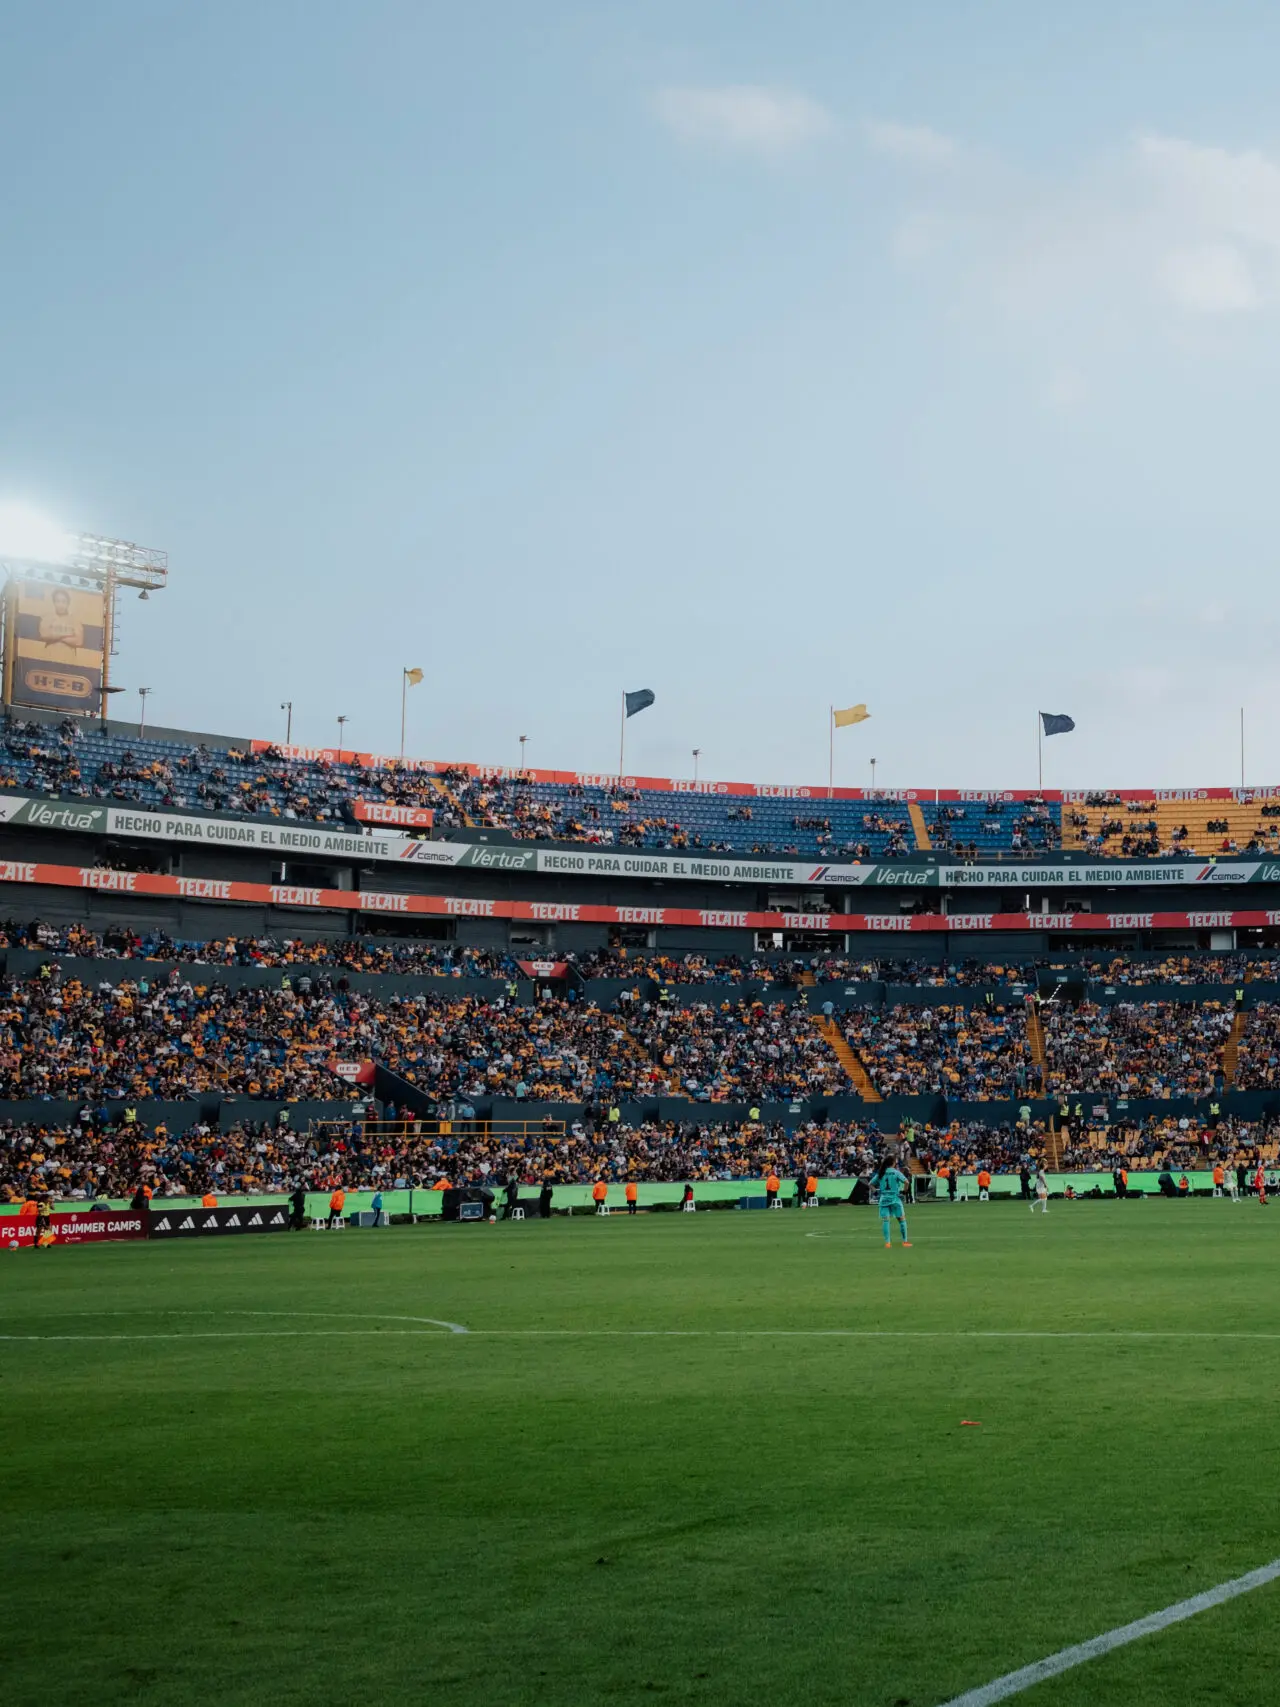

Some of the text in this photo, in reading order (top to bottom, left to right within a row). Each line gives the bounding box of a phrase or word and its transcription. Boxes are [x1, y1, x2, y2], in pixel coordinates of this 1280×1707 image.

[575, 772, 626, 786] TECATE
[669, 778, 718, 793] TECATE
[753, 784, 800, 797] TECATE
[1152, 789, 1199, 800] TECATE
[27, 803, 94, 828] Vertua
[363, 803, 417, 824] TECATE
[115, 815, 388, 855] HECHO PARA CUIDAR EL MEDIO AMBIENTE
[417, 853, 454, 862] CEMEX
[471, 848, 526, 868] Vertua
[544, 855, 794, 880] HECHO PARA CUIDAR EL MEDIO AMBIENTE
[988, 872, 1019, 883] PARA
[1021, 871, 1063, 882] CUIDAR
[1068, 871, 1082, 881] EL
[1085, 870, 1123, 881] MEDIO
[1125, 869, 1184, 881] AMBIENTE
[79, 868, 137, 891] TECATE
[876, 868, 928, 885] Vertua
[176, 877, 232, 899] TECATE
[268, 885, 322, 906] TECATE
[358, 891, 410, 911] TECATE
[444, 896, 495, 916] TECATE
[530, 902, 580, 920] TECATE
[615, 906, 665, 923] TECATE
[699, 910, 748, 927] TECATE
[1185, 911, 1233, 927] TECATE
[781, 913, 831, 929] TECATE
[864, 915, 912, 930] TECATE
[945, 914, 993, 929] TECATE
[1026, 913, 1075, 929] TECATE
[1107, 913, 1154, 928] TECATE
[2, 1220, 141, 1238] FC BAYN SUMMER CAMPS
